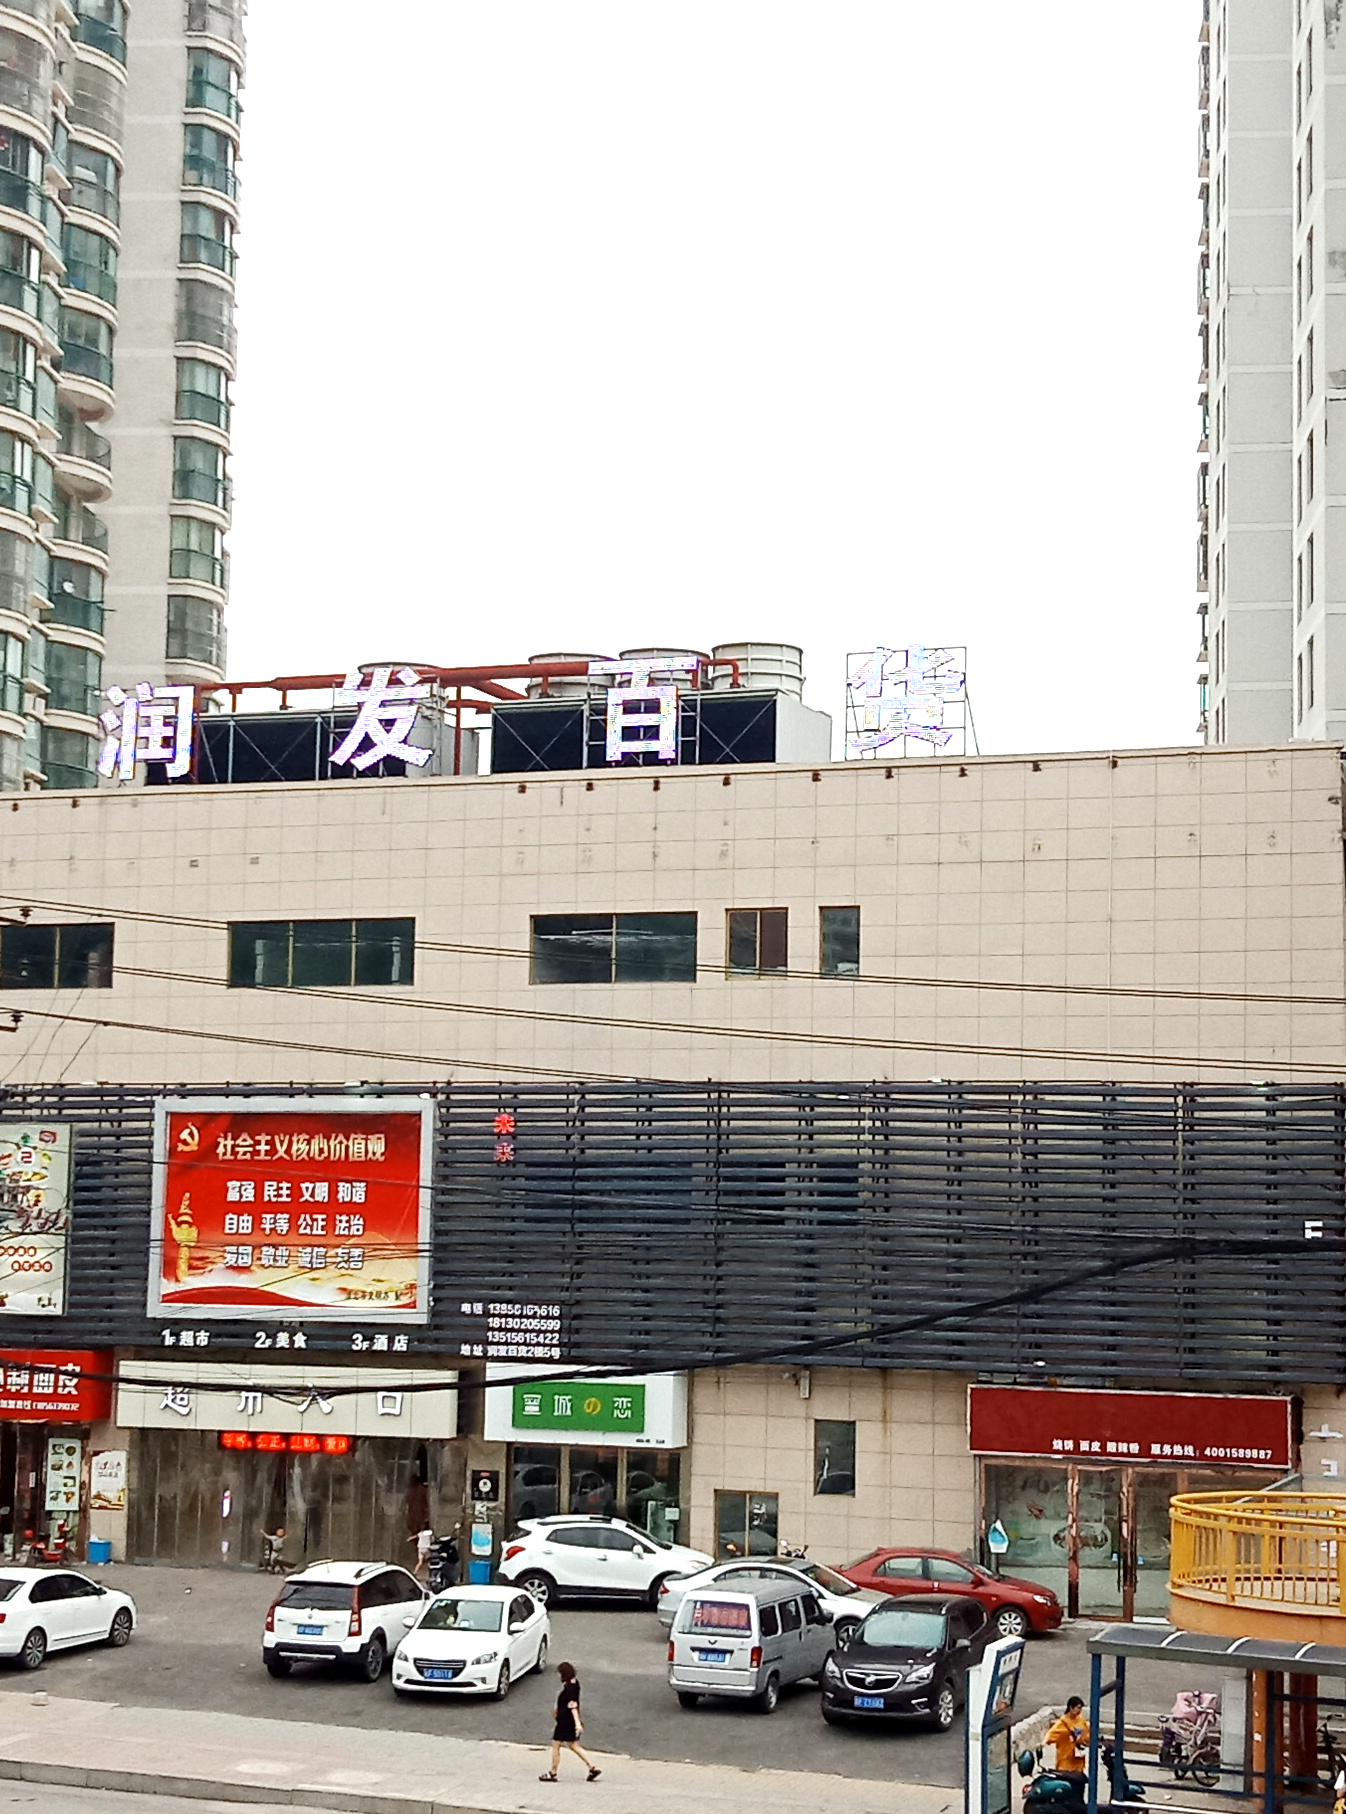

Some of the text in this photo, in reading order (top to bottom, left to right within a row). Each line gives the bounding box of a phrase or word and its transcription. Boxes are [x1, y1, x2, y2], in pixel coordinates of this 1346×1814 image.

[97, 644, 967, 781] 润发百货
[216, 1133, 386, 1162] 社会主义核心价值观
[226, 1180, 367, 1204] 富强 民主 文明 和谐
[224, 1213, 364, 1236] 自由 平等 公正 法治
[224, 1246, 365, 1269] 爱国 敬业 诚信 友善
[487, 1317, 561, 1330] 18130205599
[162, 1329, 210, 1346] 1F 超市
[254, 1331, 308, 1348] 2F 美食
[351, 1333, 410, 1351] 3F 酒店
[486, 1331, 560, 1344] 13515615422
[460, 1343, 483, 1356] 地址
[159, 1380, 404, 1415] 超市入口
[1079, 1440, 1101, 1452] 面皮
